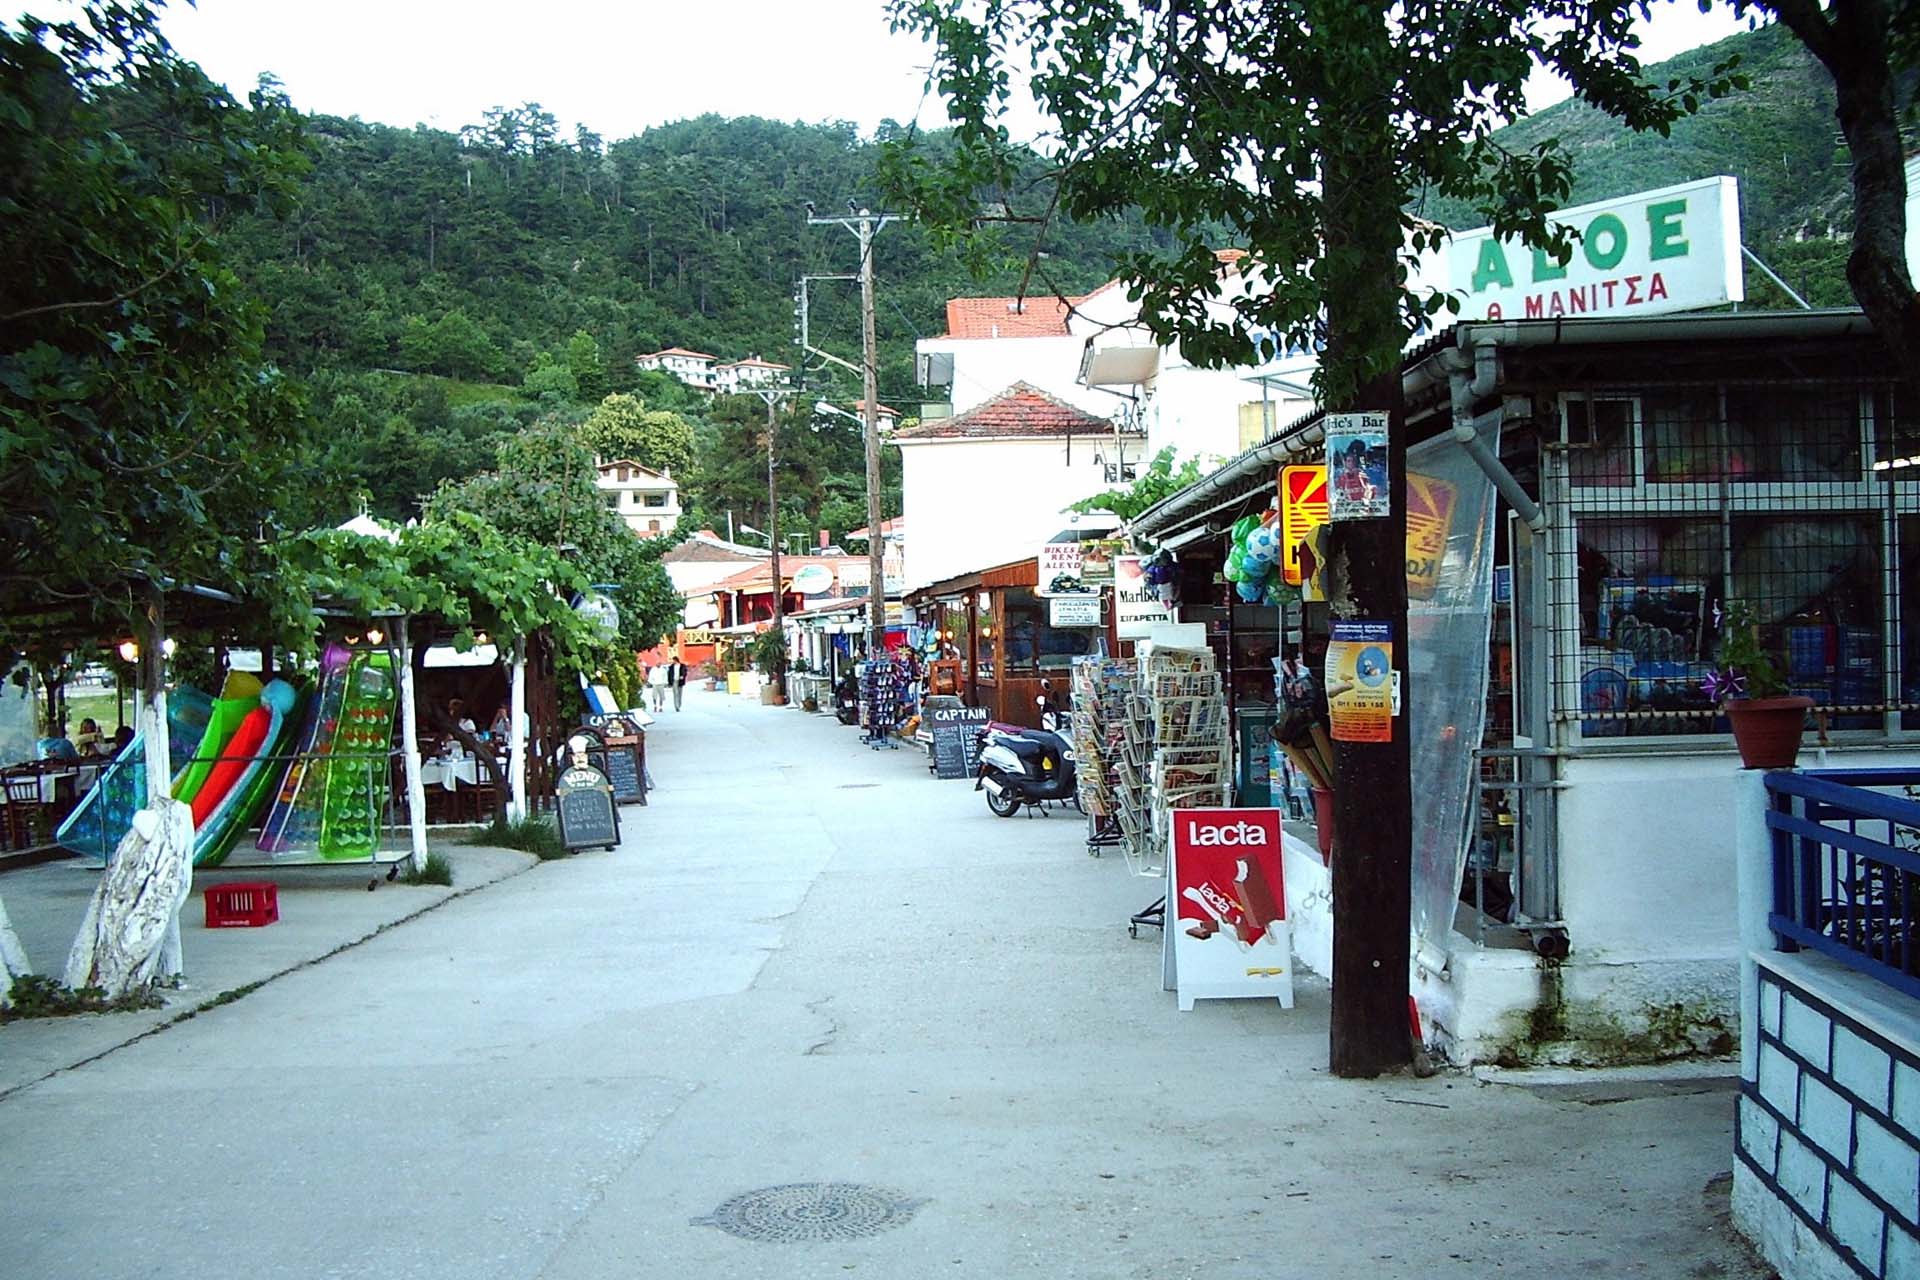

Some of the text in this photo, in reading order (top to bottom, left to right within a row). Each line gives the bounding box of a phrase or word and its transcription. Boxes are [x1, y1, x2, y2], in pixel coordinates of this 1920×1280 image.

[1362, 416, 1385, 428] Bar
[1044, 546, 1076, 554] BIKES
[935, 708, 987, 721] CAPTAIN
[563, 771, 601, 784] MENU
[1188, 820, 1268, 846] Lacta
